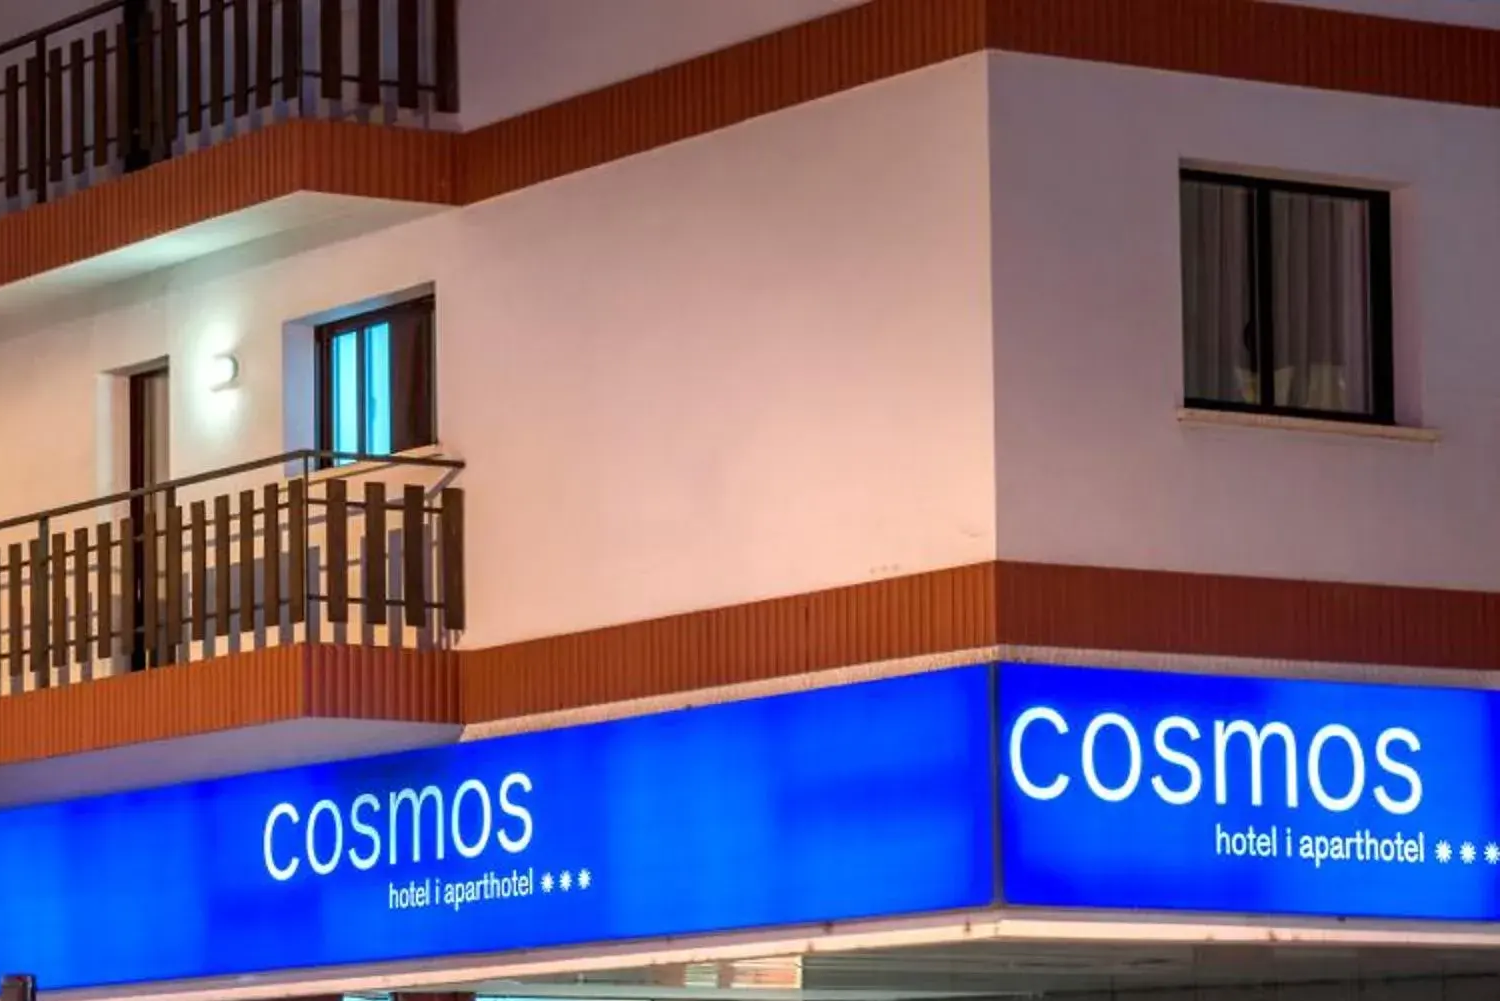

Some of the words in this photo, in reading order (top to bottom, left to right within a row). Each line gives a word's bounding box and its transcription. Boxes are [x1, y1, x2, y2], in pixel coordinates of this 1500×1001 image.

[1008, 706, 1423, 815] cosmos
[263, 771, 534, 882] cosmos
[1215, 823, 1277, 858] hotel
[1286, 827, 1292, 858] i
[1300, 829, 1425, 868] aparthotel
[388, 879, 430, 910] hotel
[435, 879, 440, 905] i
[443, 867, 534, 912] aparthotel
